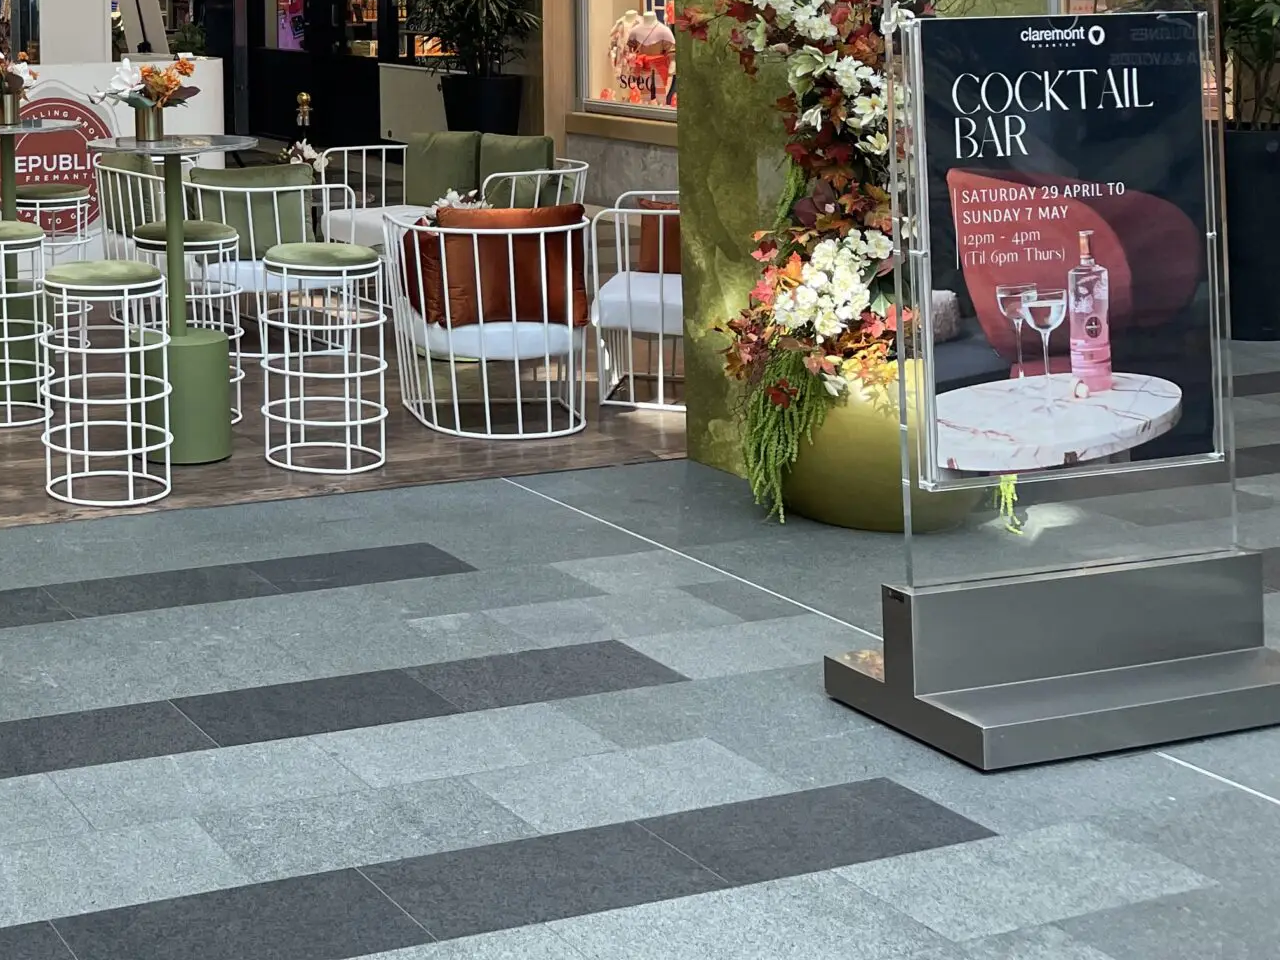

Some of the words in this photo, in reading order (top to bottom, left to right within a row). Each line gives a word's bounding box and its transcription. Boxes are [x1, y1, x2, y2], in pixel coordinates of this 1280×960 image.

[1020, 26, 1085, 42] claremont
[620, 69, 656, 101] seed
[951, 68, 1154, 115] COCKTAIL
[954, 115, 1029, 159] BAR
[14, 153, 103, 174] EPUBLIC
[26, 172, 97, 183] FREMANTL
[962, 187, 1036, 204] SATURDAY
[1041, 185, 1059, 200] 29
[1064, 183, 1103, 198] APRIL
[1107, 182, 1125, 196] TO
[963, 208, 1021, 225] SUNDAY
[1025, 208, 1033, 221] 7
[1038, 205, 1069, 220] MAY
[963, 233, 995, 248] 12pm
[1011, 230, 1041, 245] 4pm
[964, 251, 987, 268] (Til
[990, 250, 1019, 267] 6pm
[1023, 247, 1066, 262] Thurs)
